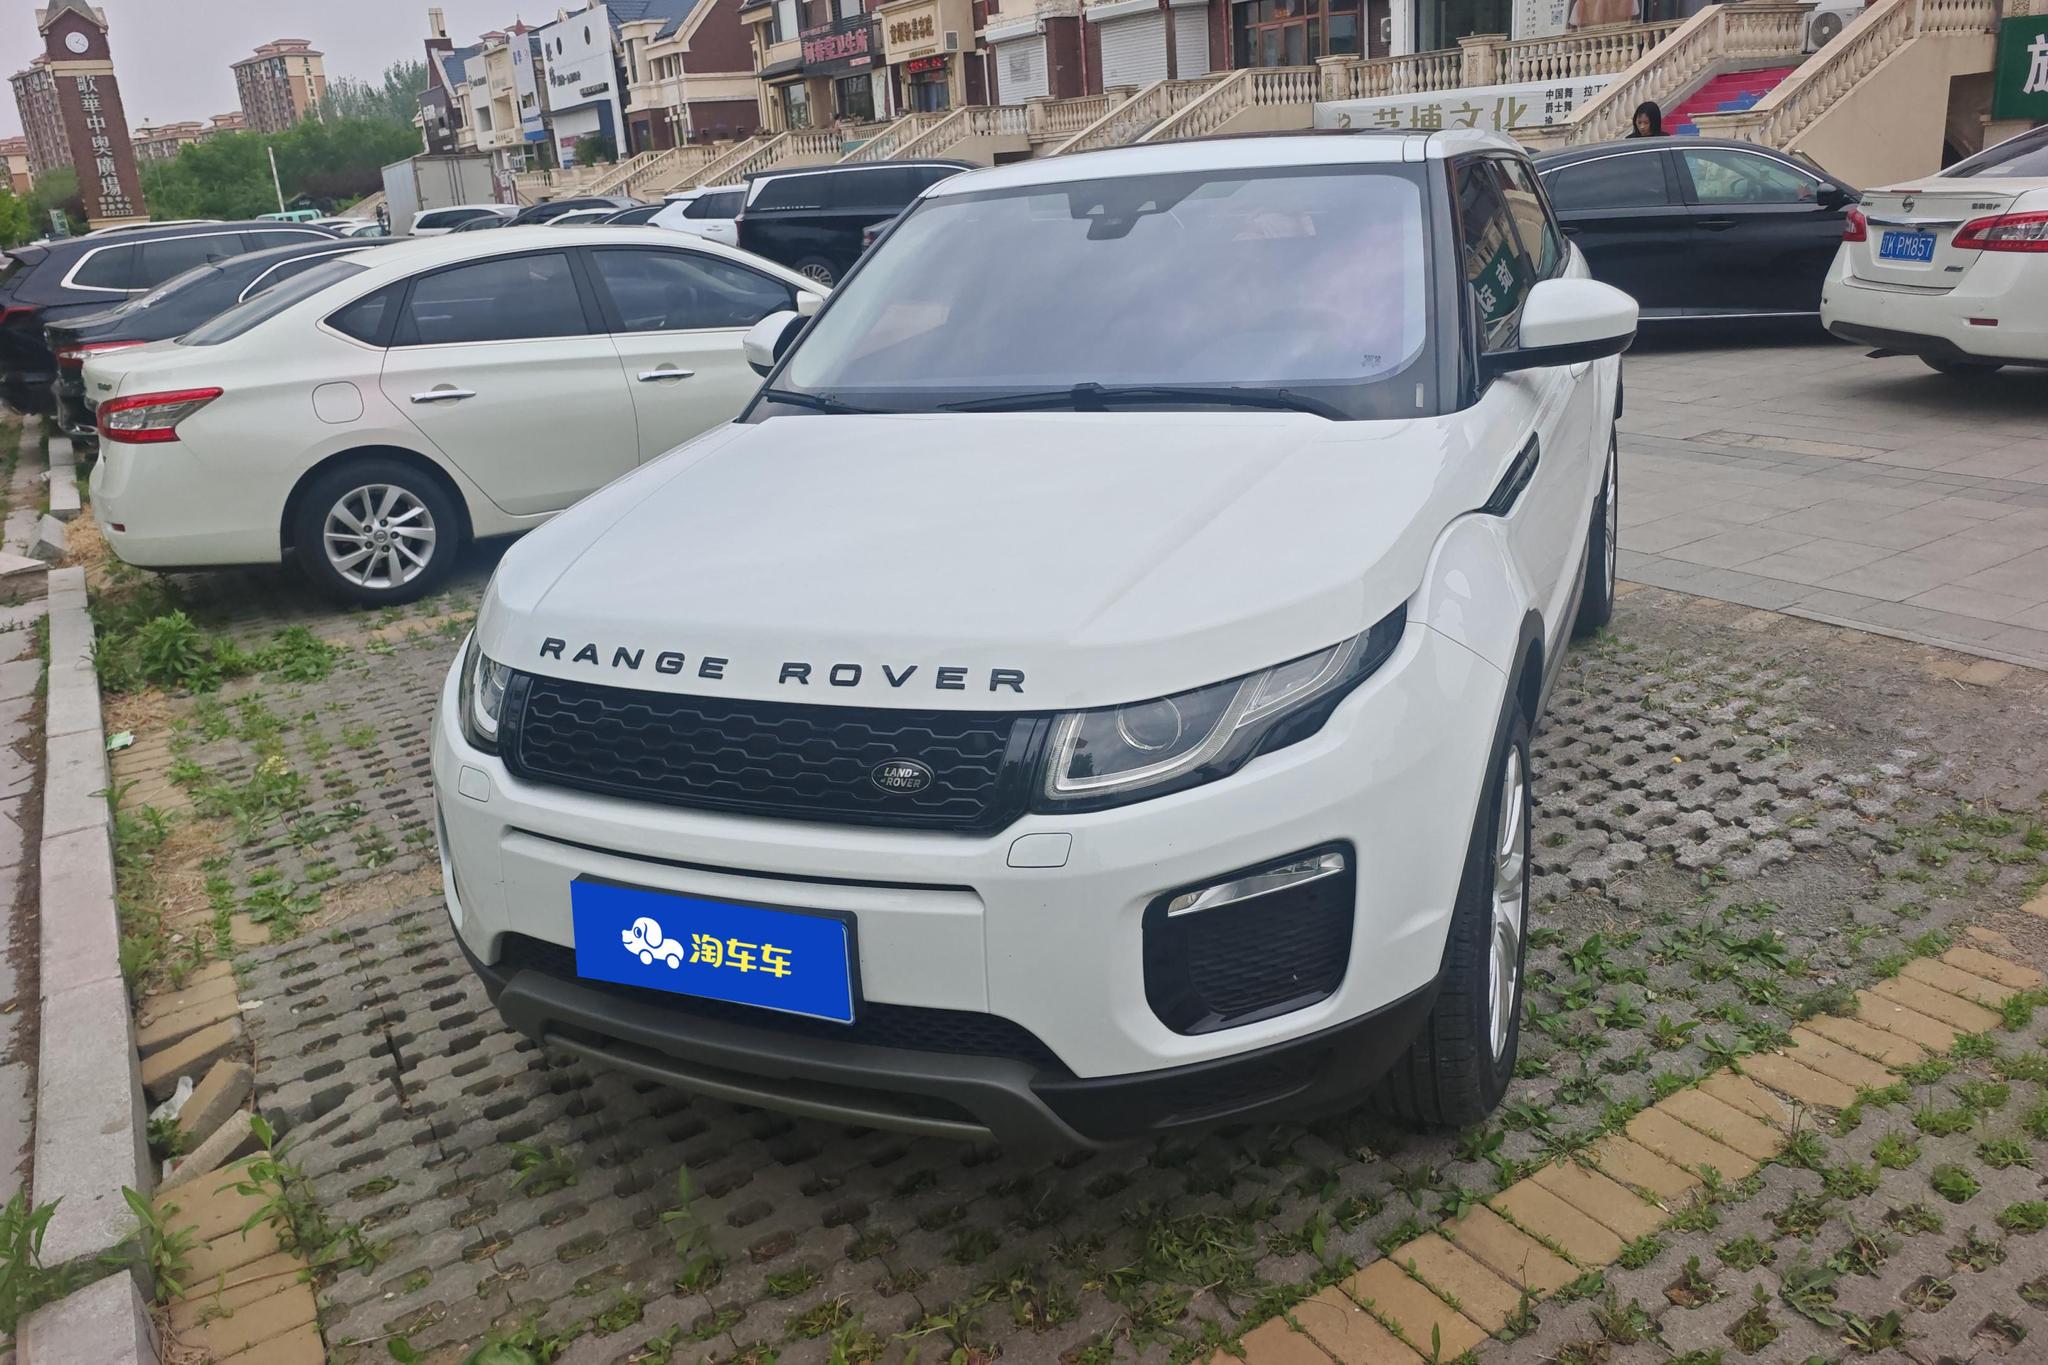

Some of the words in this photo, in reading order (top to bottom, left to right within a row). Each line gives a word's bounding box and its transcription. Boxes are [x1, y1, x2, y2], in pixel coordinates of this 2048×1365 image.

[1545, 88, 1573, 100] 中国舞
[1583, 84, 1608, 97] 拉丁
[1373, 96, 1528, 131] 艺博文化
[1545, 101, 1572, 113] 爵士舞
[540, 637, 729, 680] RANGE
[778, 662, 1025, 694] ROVER
[884, 767, 913, 778] LAND
[885, 777, 921, 788] ROVER
